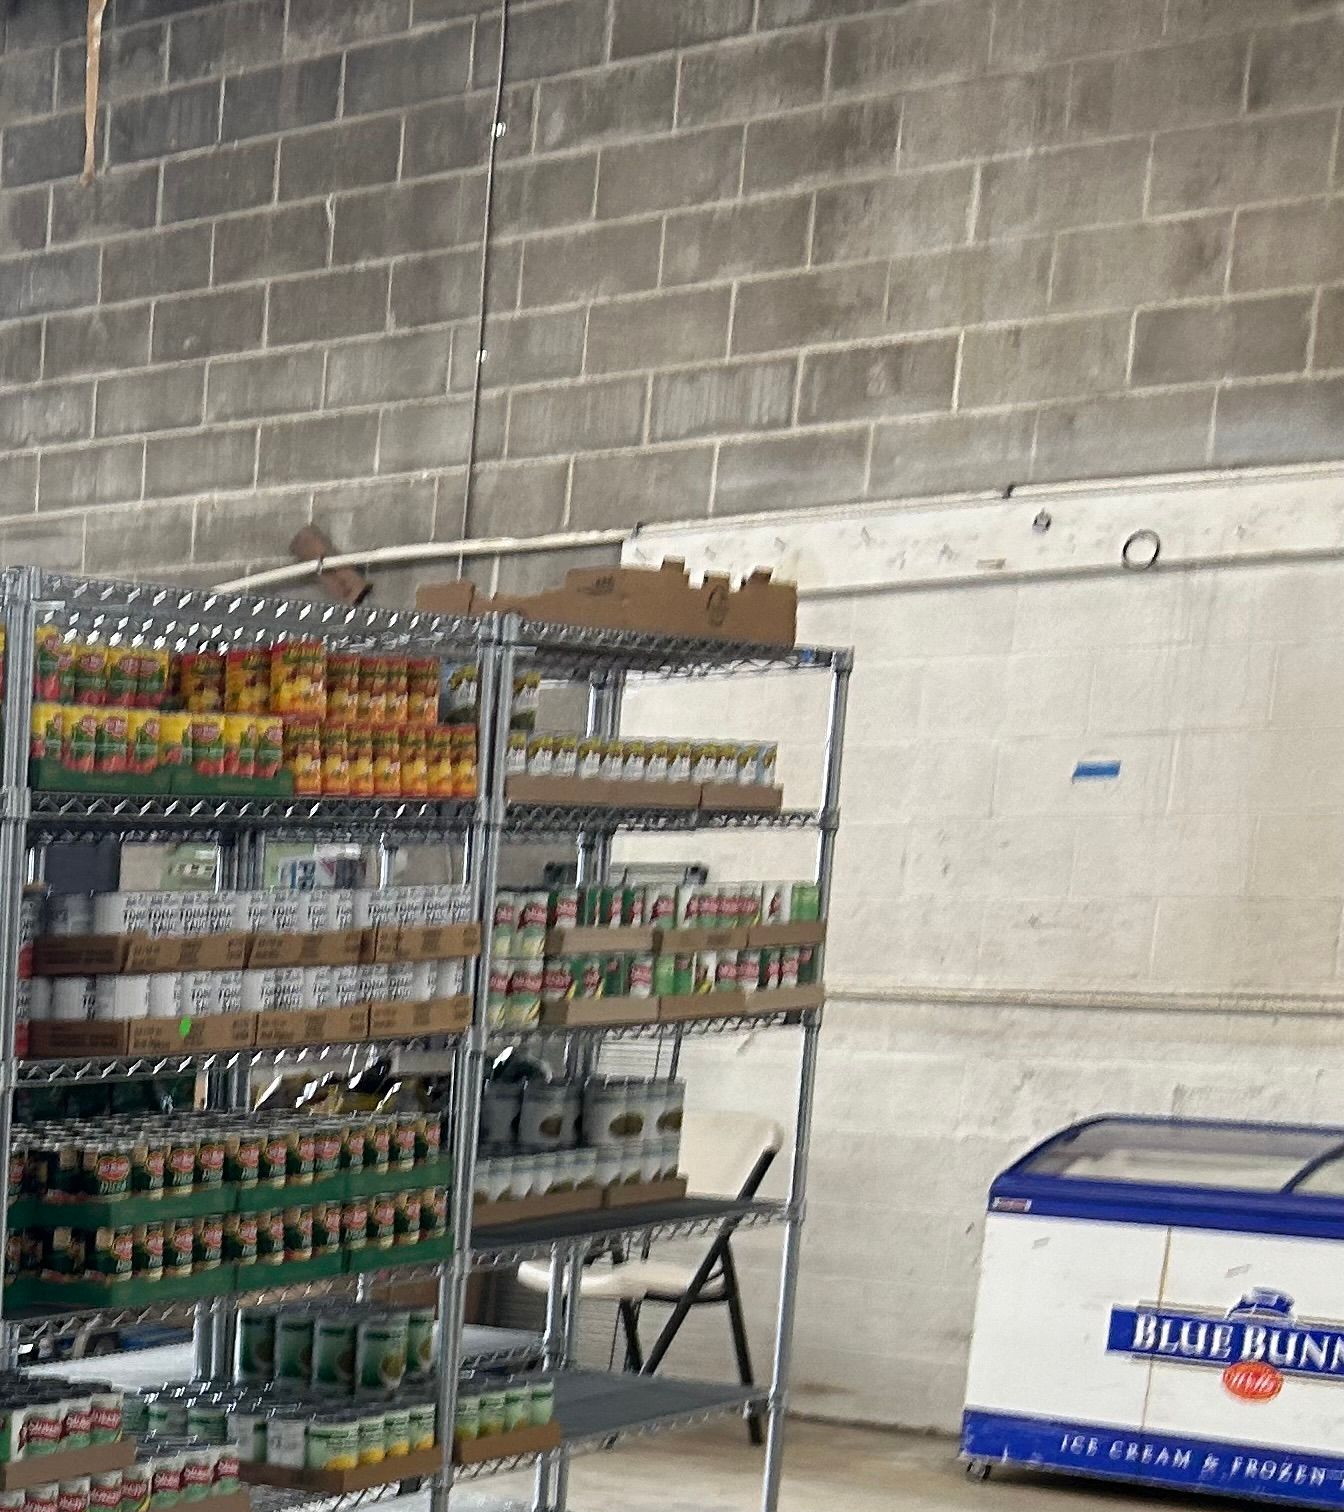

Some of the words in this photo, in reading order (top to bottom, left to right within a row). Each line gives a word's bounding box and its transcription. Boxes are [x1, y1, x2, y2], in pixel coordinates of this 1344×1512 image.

[1132, 1313, 1234, 1358] BLUE
[1060, 1433, 1098, 1457] ICE
[1108, 1440, 1193, 1470] CREAM
[1229, 1456, 1327, 1488] FROZEN
